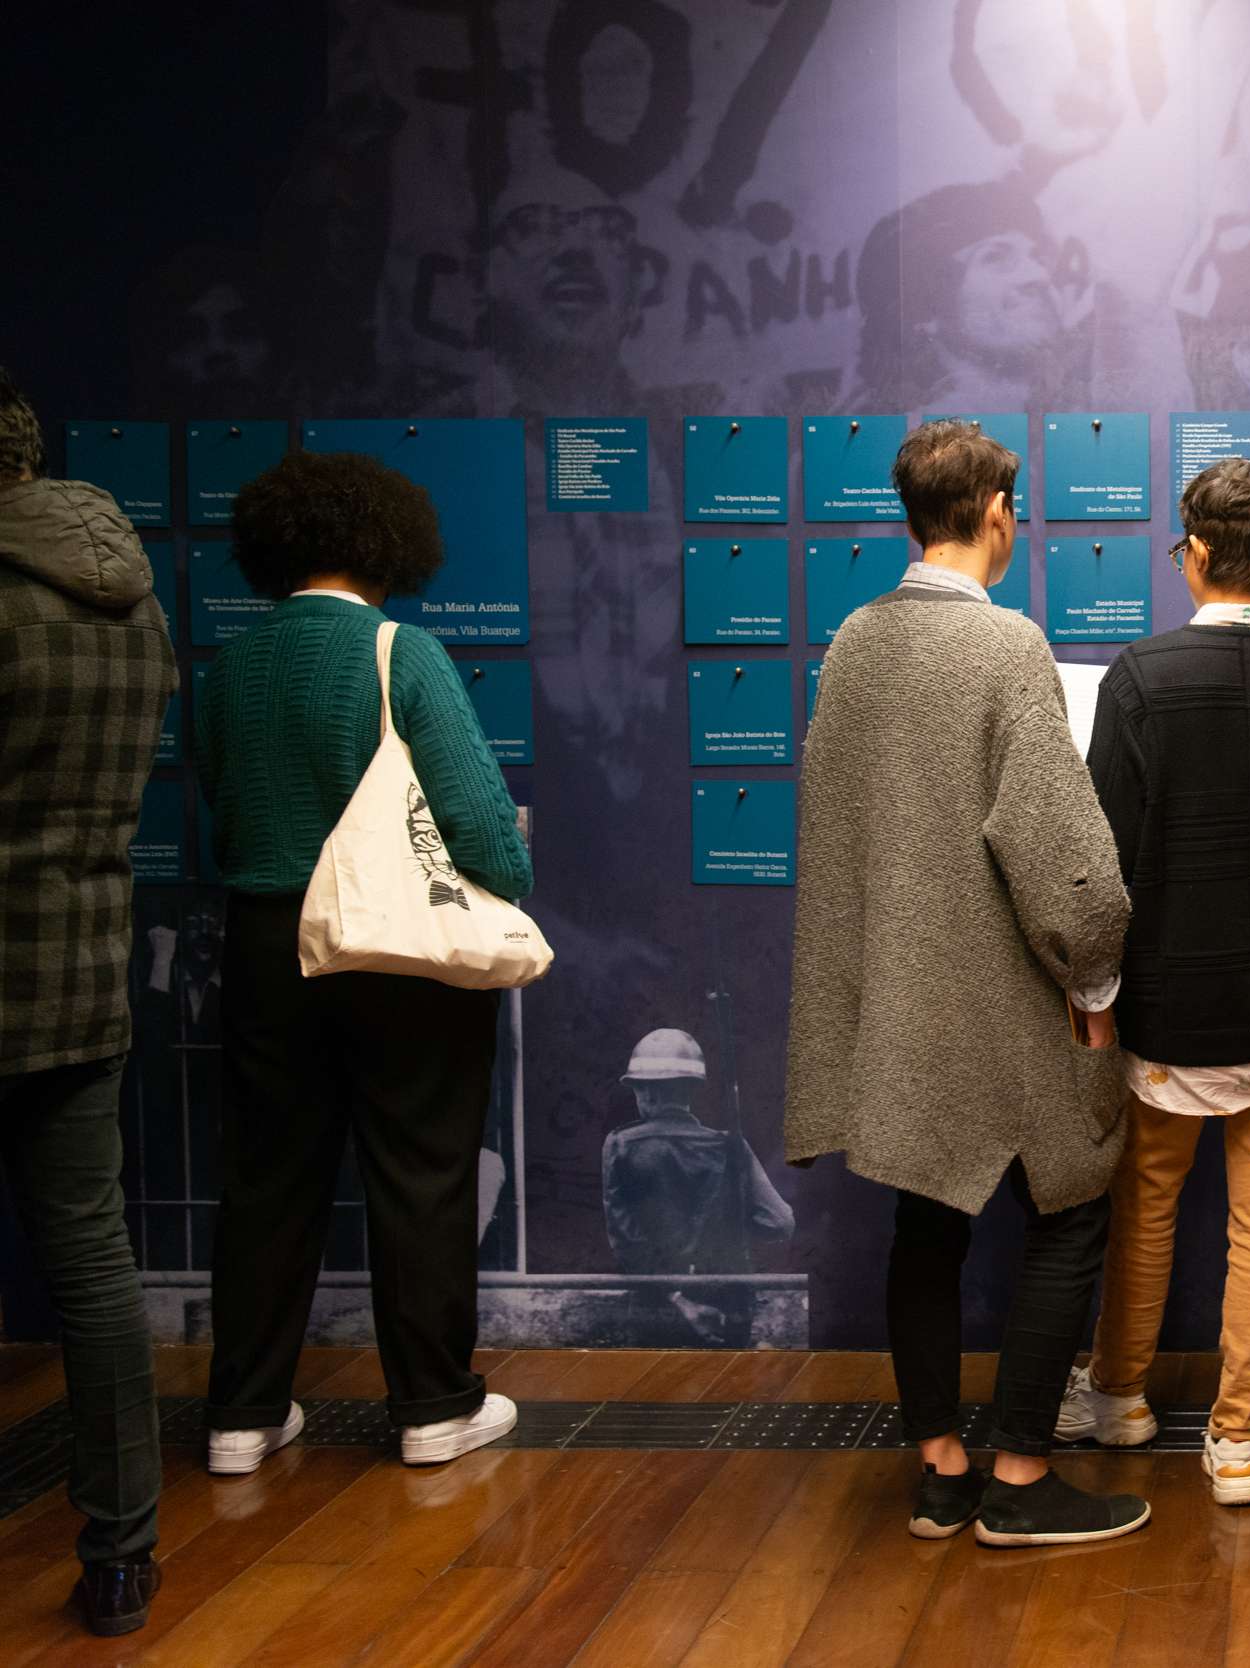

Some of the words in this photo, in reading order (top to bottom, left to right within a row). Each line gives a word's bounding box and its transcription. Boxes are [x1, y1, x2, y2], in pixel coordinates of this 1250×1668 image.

[422, 602, 443, 612] Rua
[444, 602, 476, 612] Maria
[478, 602, 520, 612] Antônia
[460, 626, 478, 637] Vila
[480, 626, 520, 637] Buarque
